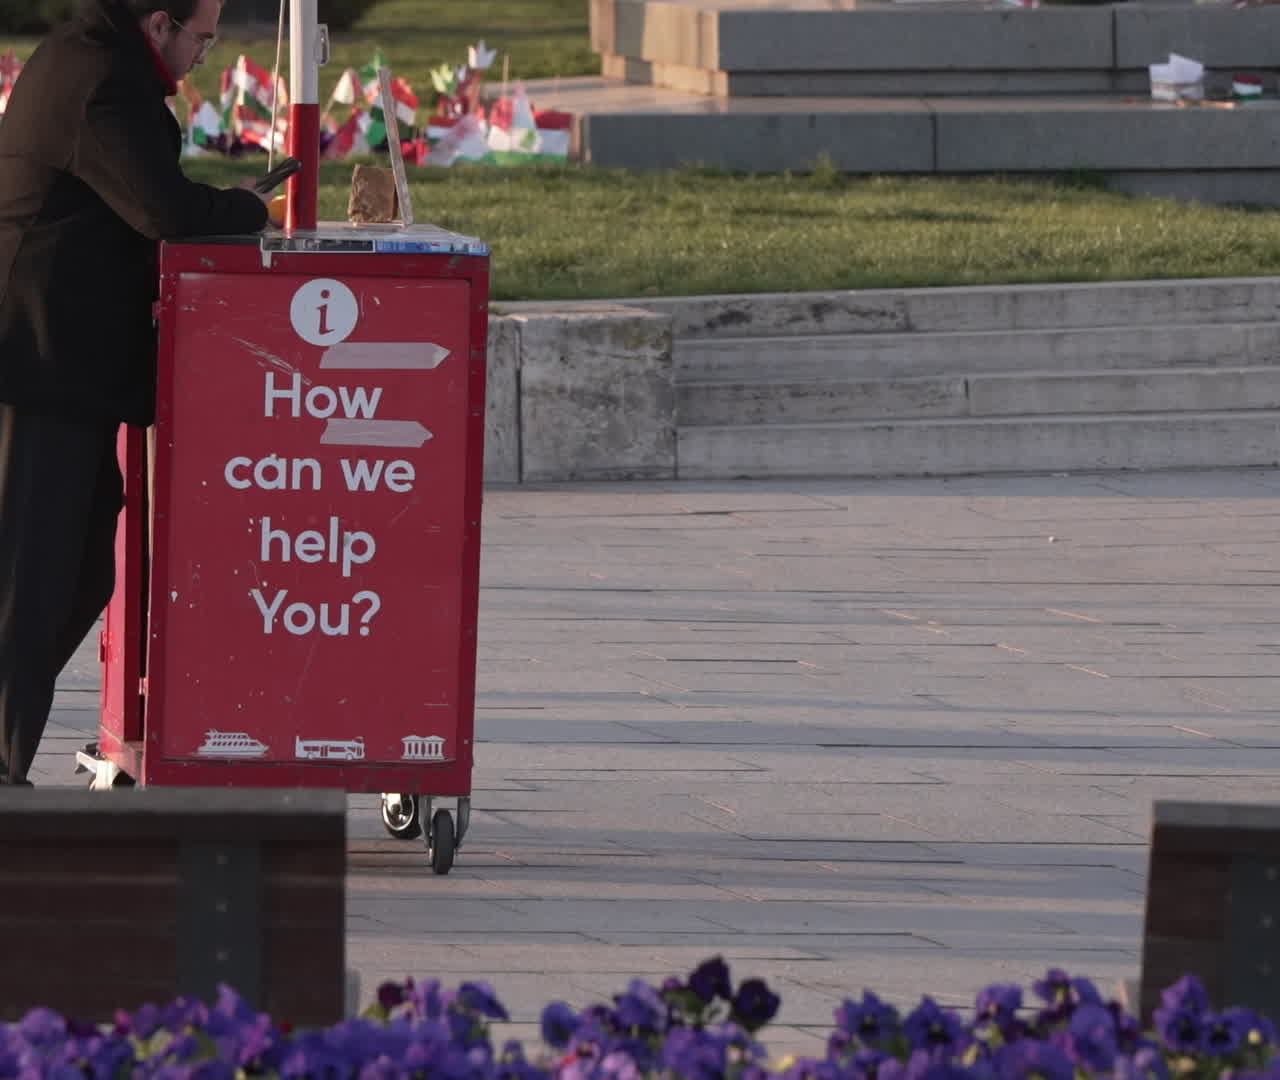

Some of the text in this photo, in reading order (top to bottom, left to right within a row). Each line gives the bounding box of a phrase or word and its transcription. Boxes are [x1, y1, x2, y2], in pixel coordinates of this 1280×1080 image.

[264, 371, 383, 419] How
[224, 453, 416, 493] can we
[260, 516, 376, 578] help
[251, 588, 381, 637] You?
